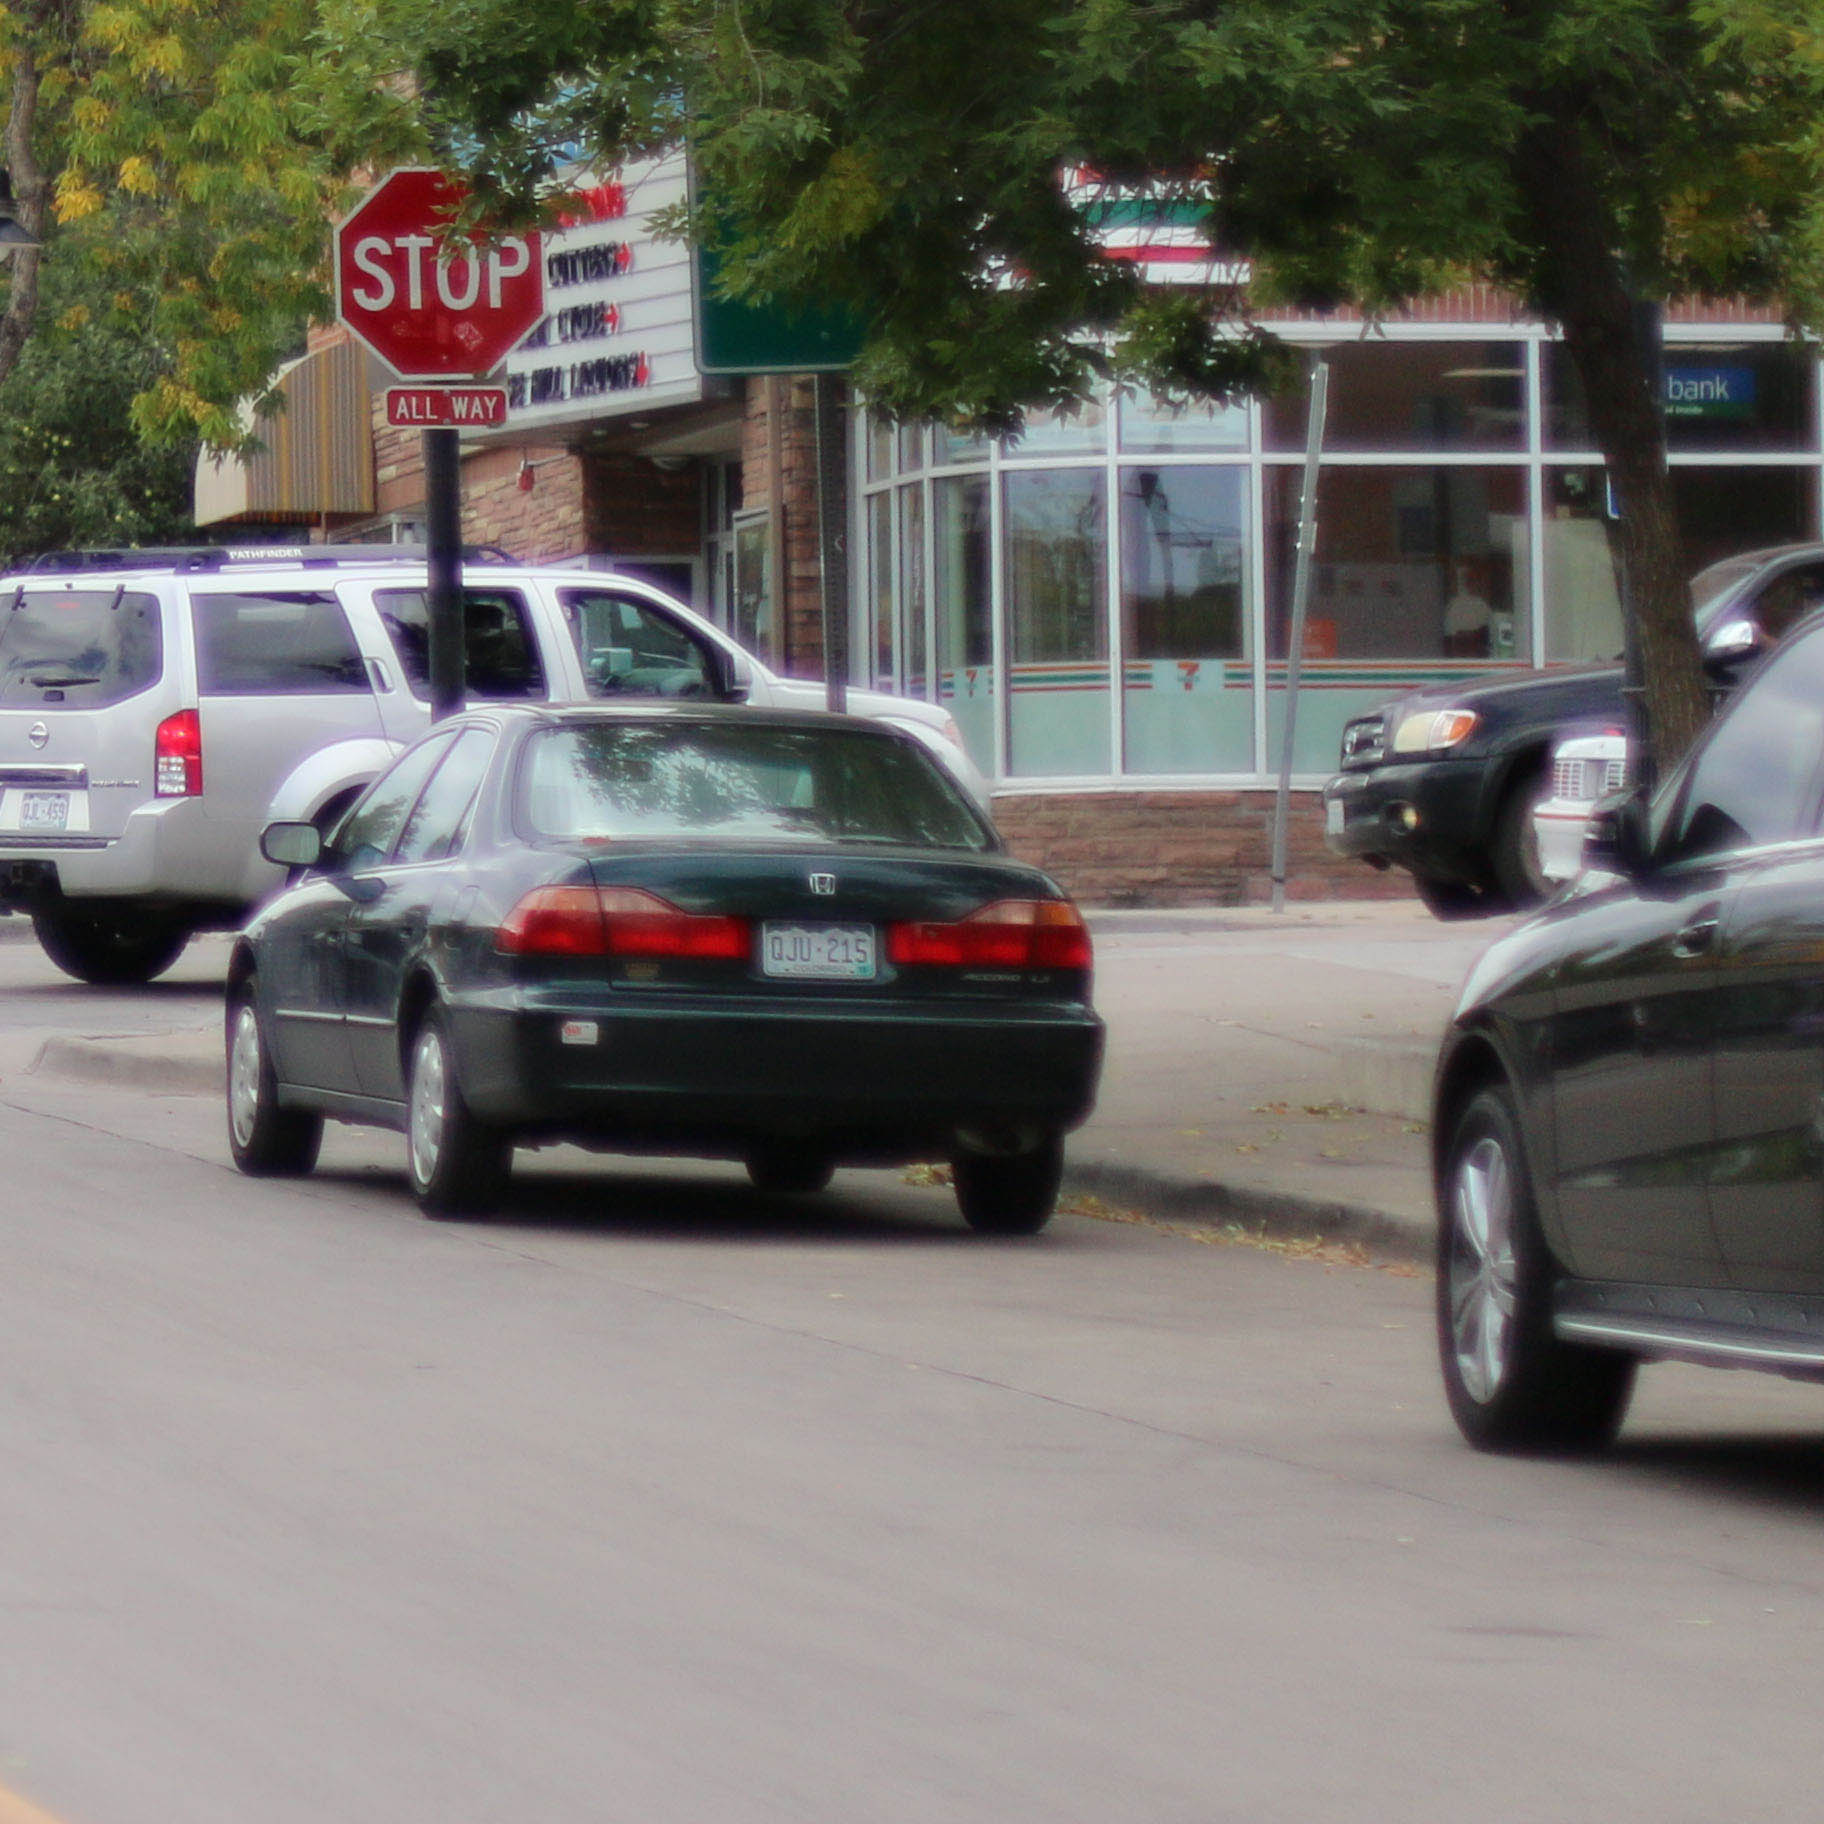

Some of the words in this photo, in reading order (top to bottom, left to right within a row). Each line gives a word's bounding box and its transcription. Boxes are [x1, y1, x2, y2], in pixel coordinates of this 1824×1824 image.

[352, 234, 530, 312] STOP
[1668, 374, 1730, 401] bank
[395, 395, 438, 420] ALL
[451, 395, 498, 419] WAY
[228, 547, 304, 560] PATHFINDER
